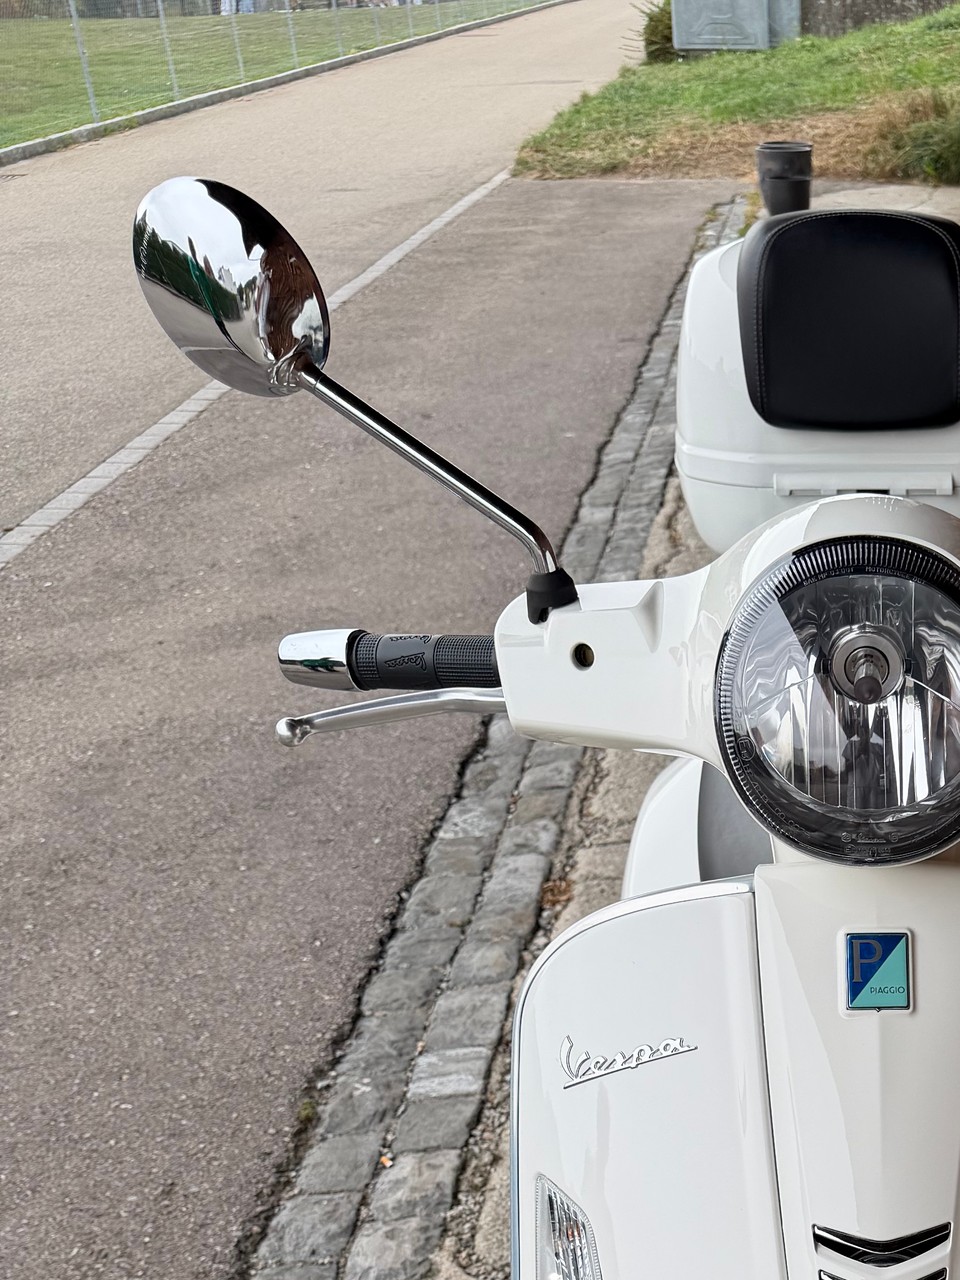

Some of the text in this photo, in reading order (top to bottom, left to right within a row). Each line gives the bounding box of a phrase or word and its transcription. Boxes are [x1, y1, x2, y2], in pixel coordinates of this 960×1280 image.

[384, 652, 427, 671] Vespa
[851, 939, 883, 983] P
[869, 985, 906, 995] PIAGGIO
[560, 1034, 698, 1090] Vespa
